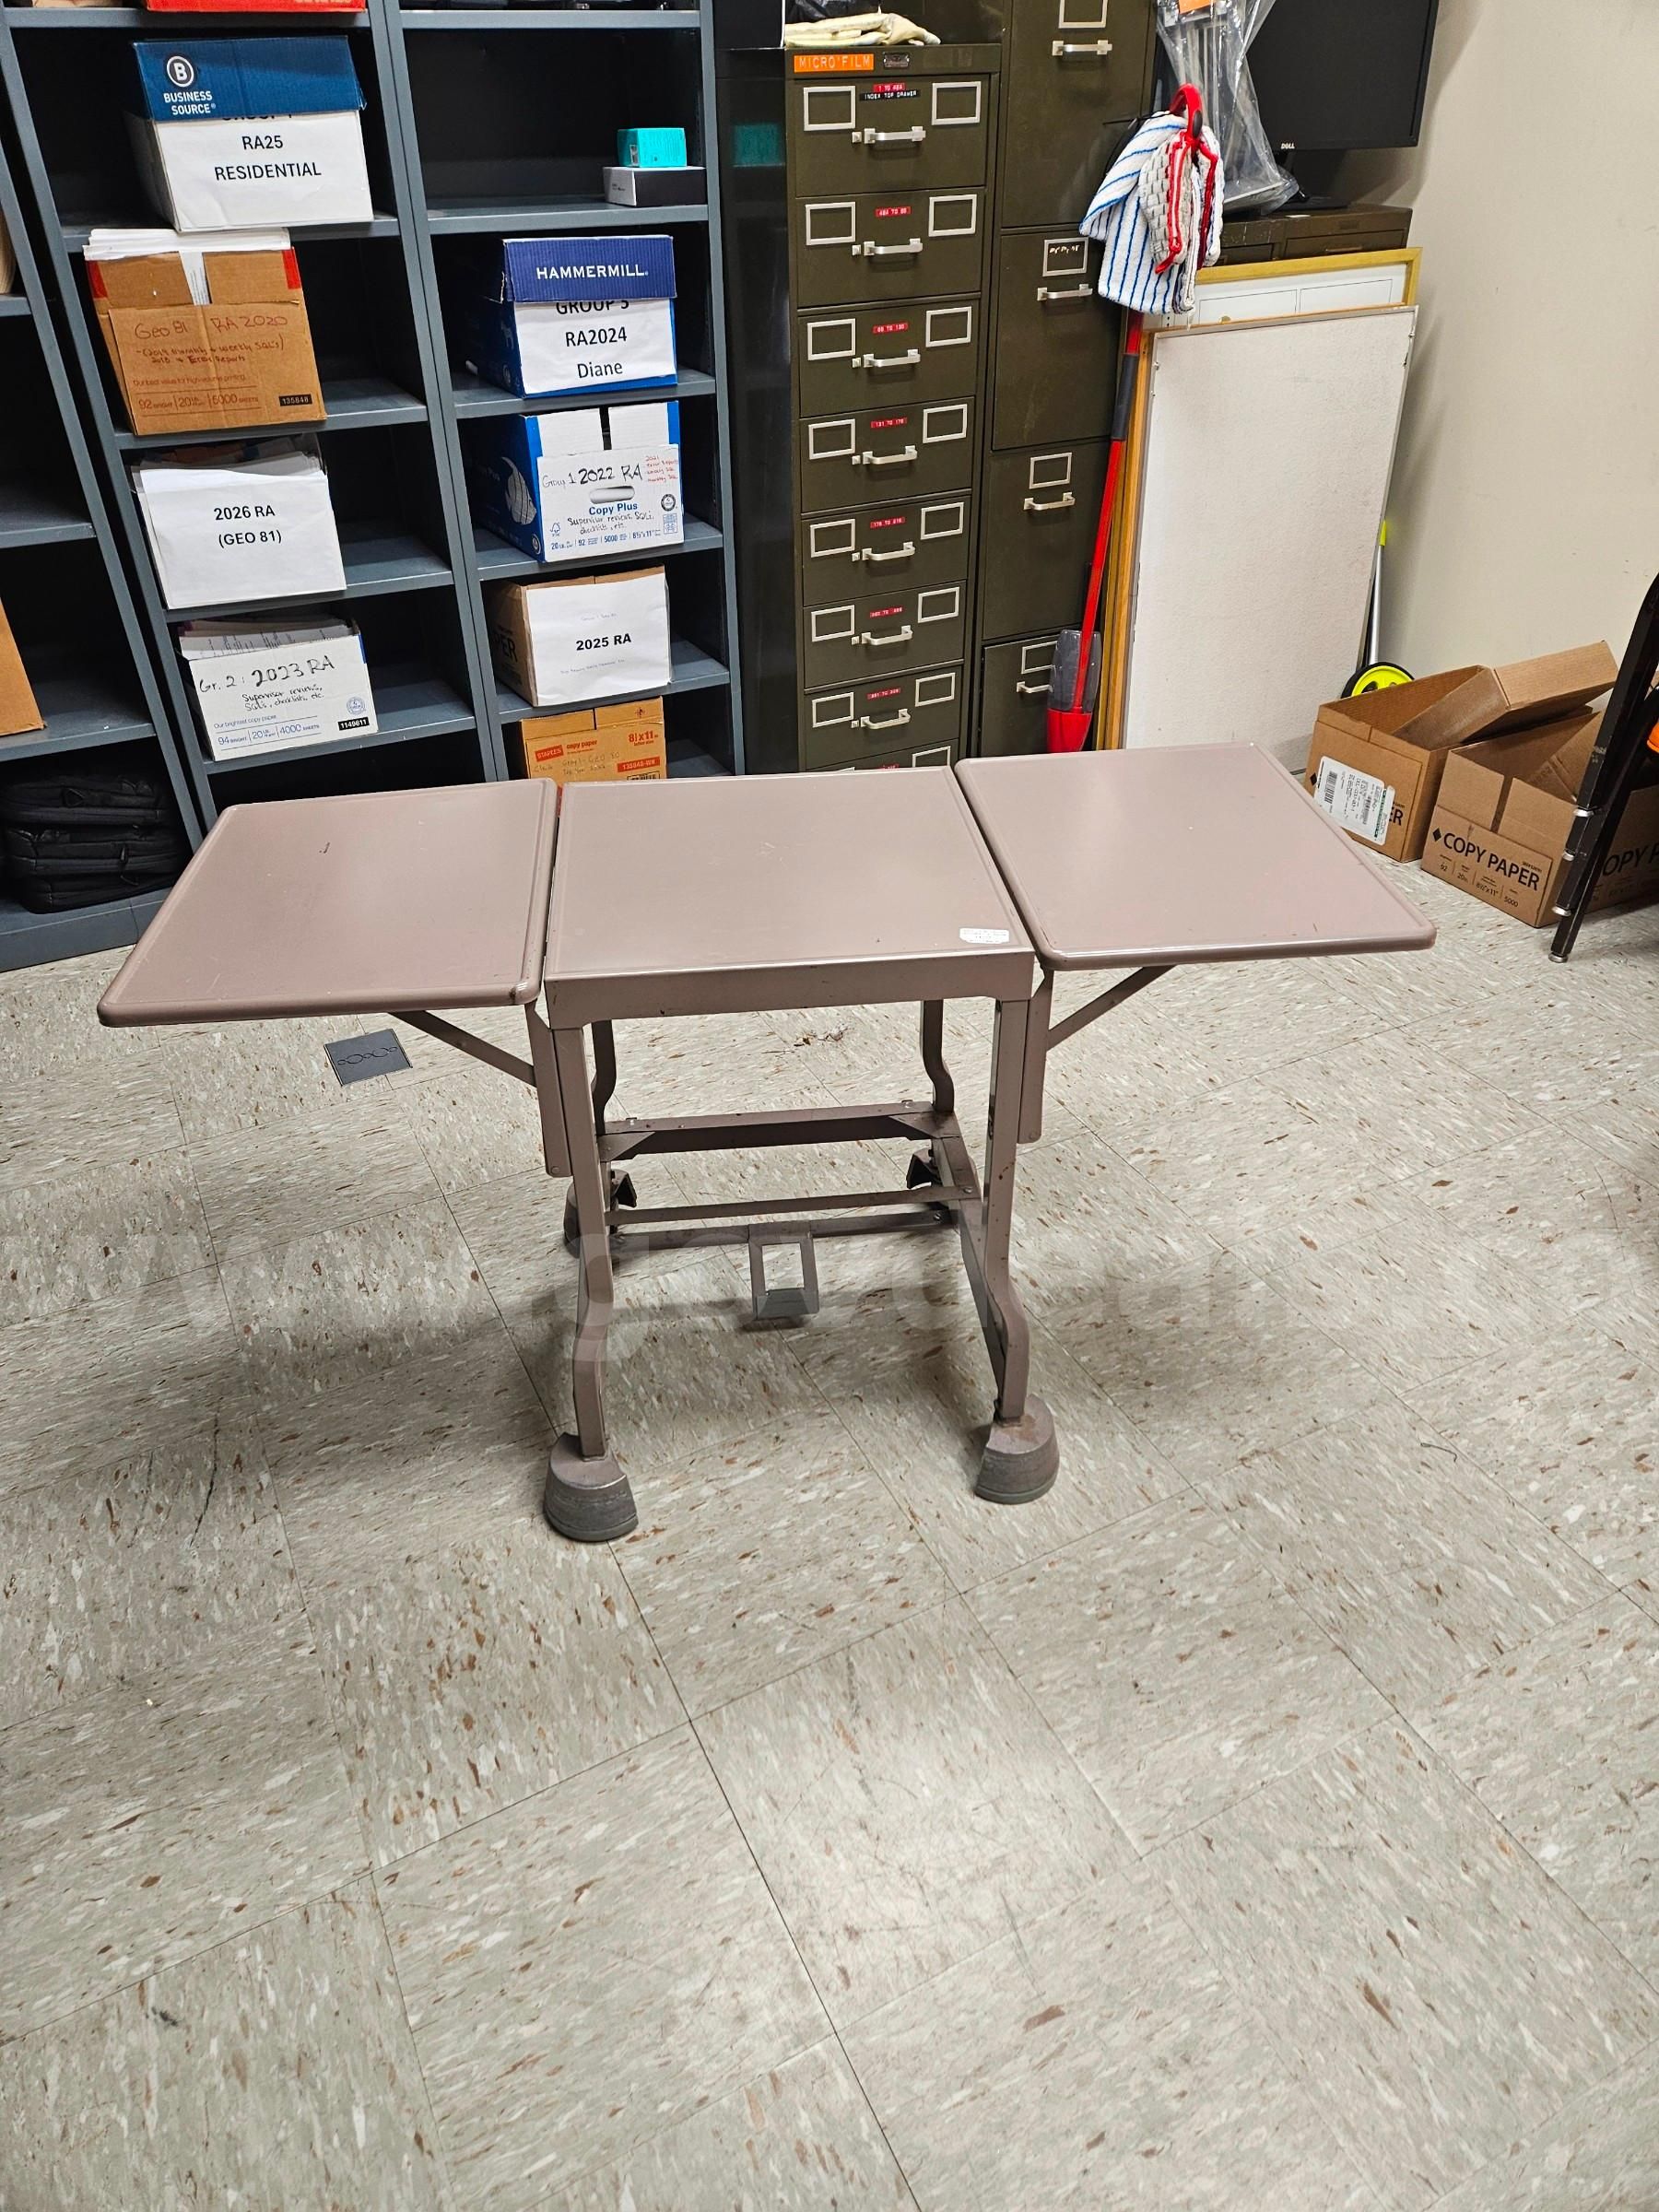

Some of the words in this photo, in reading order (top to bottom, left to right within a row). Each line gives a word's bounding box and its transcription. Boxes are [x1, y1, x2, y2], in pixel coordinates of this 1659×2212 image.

[163, 90, 213, 103] BUSINESS
[241, 135, 284, 150] RA25
[214, 161, 323, 182] RESIDENTIAL
[535, 264, 645, 280] HAMMERMILL
[556, 300, 616, 315] GROUP
[134, 323, 171, 340] Geo
[210, 316, 240, 334] RA
[239, 315, 288, 328] 2020
[565, 326, 628, 347] RA2024
[577, 361, 624, 379] Diane
[138, 399, 152, 410] 92
[178, 397, 192, 407] 20
[568, 472, 577, 484] 1
[578, 467, 616, 485] 2022
[620, 463, 643, 482] RA
[213, 506, 252, 521] 2026
[254, 504, 276, 518] RA
[588, 506, 614, 516] Copy
[617, 502, 638, 512] Plus
[218, 532, 256, 548] (GEO
[259, 529, 282, 544] 81)
[604, 535, 618, 543] 5000
[575, 636, 609, 651] 2025
[613, 632, 632, 646] RA
[251, 663, 305, 688] 2023
[306, 654, 335, 675] RA
[252, 730, 264, 739] 20
[279, 724, 301, 735] 4000
[218, 736, 229, 746] 94
[581, 740, 598, 748] paper
[536, 747, 561, 759] STAPLES
[1443, 832, 1488, 864] COPY
[1487, 853, 1540, 891] PAPER
[1602, 843, 1649, 877] OPY
[1503, 895, 1519, 908] 5000
